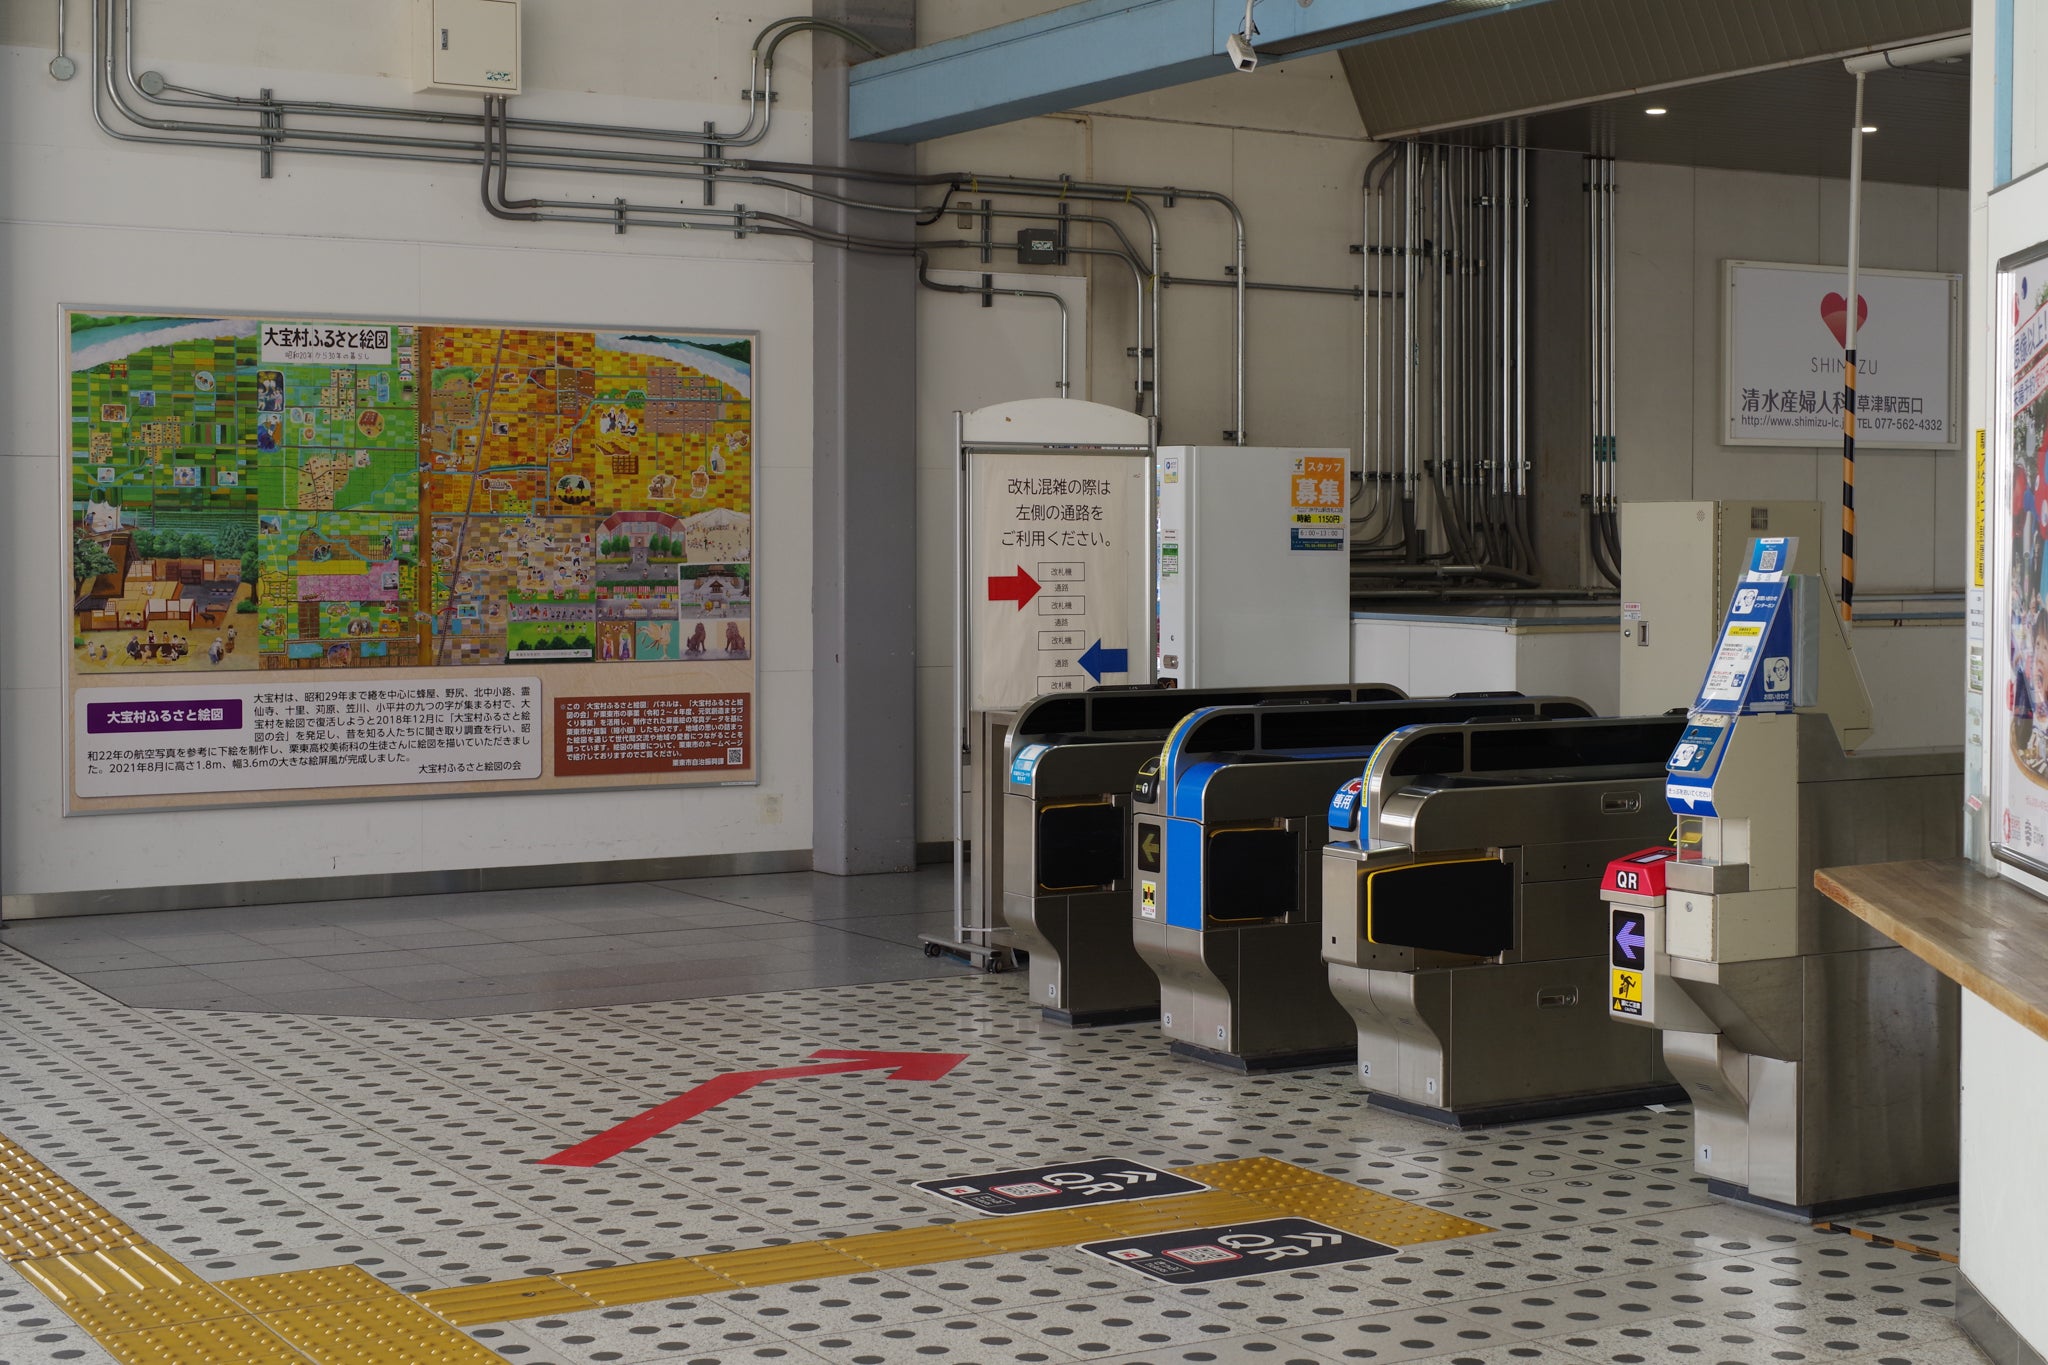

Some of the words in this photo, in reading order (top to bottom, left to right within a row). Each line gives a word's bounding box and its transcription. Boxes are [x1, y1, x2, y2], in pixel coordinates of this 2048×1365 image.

[263, 327, 389, 350] 大宝村ふるさと絵図
[1811, 357, 1878, 375] SHIMZU
[1741, 388, 1846, 415] 清水産婦人科
[1857, 395, 1924, 414] 草津駅西口
[1741, 414, 1846, 429] http://www.shimizu-lc.j
[1857, 419, 1873, 429] TEL
[1874, 418, 1943, 431] 077-562-4332
[1307, 462, 1342, 473] スタッフ
[1007, 478, 1111, 496] 改札混雑の際は
[1295, 478, 1340, 505] 募集
[1015, 504, 1104, 521] 左側の通路を
[1296, 514, 1312, 523] 時給
[1318, 515, 1340, 523] 1150円
[1001, 530, 1112, 547] ご利用ください。
[1050, 568, 1073, 576] 改札機
[1054, 583, 1069, 592] 通路
[1050, 601, 1073, 610] 改札機
[1054, 618, 1069, 627] 通路
[1050, 636, 1073, 645] 改札機
[1054, 659, 1069, 668] 通路
[1050, 681, 1073, 690] 改札機
[107, 708, 224, 725] 大宝村ふるさと絵図
[418, 760, 522, 775] 大宝村ふるさと絵図の会
[1333, 793, 1354, 810] 専用
[1617, 871, 1637, 890] QR
[1165, 1015, 1171, 1025] 3
[1218, 1028, 1223, 1037] 2
[1364, 1064, 1369, 1074] 2
[1428, 1081, 1434, 1091] 1
[1703, 1148, 1708, 1159] 1
[1041, 1172, 1125, 1196] QR
[1217, 1233, 1310, 1262] QR
